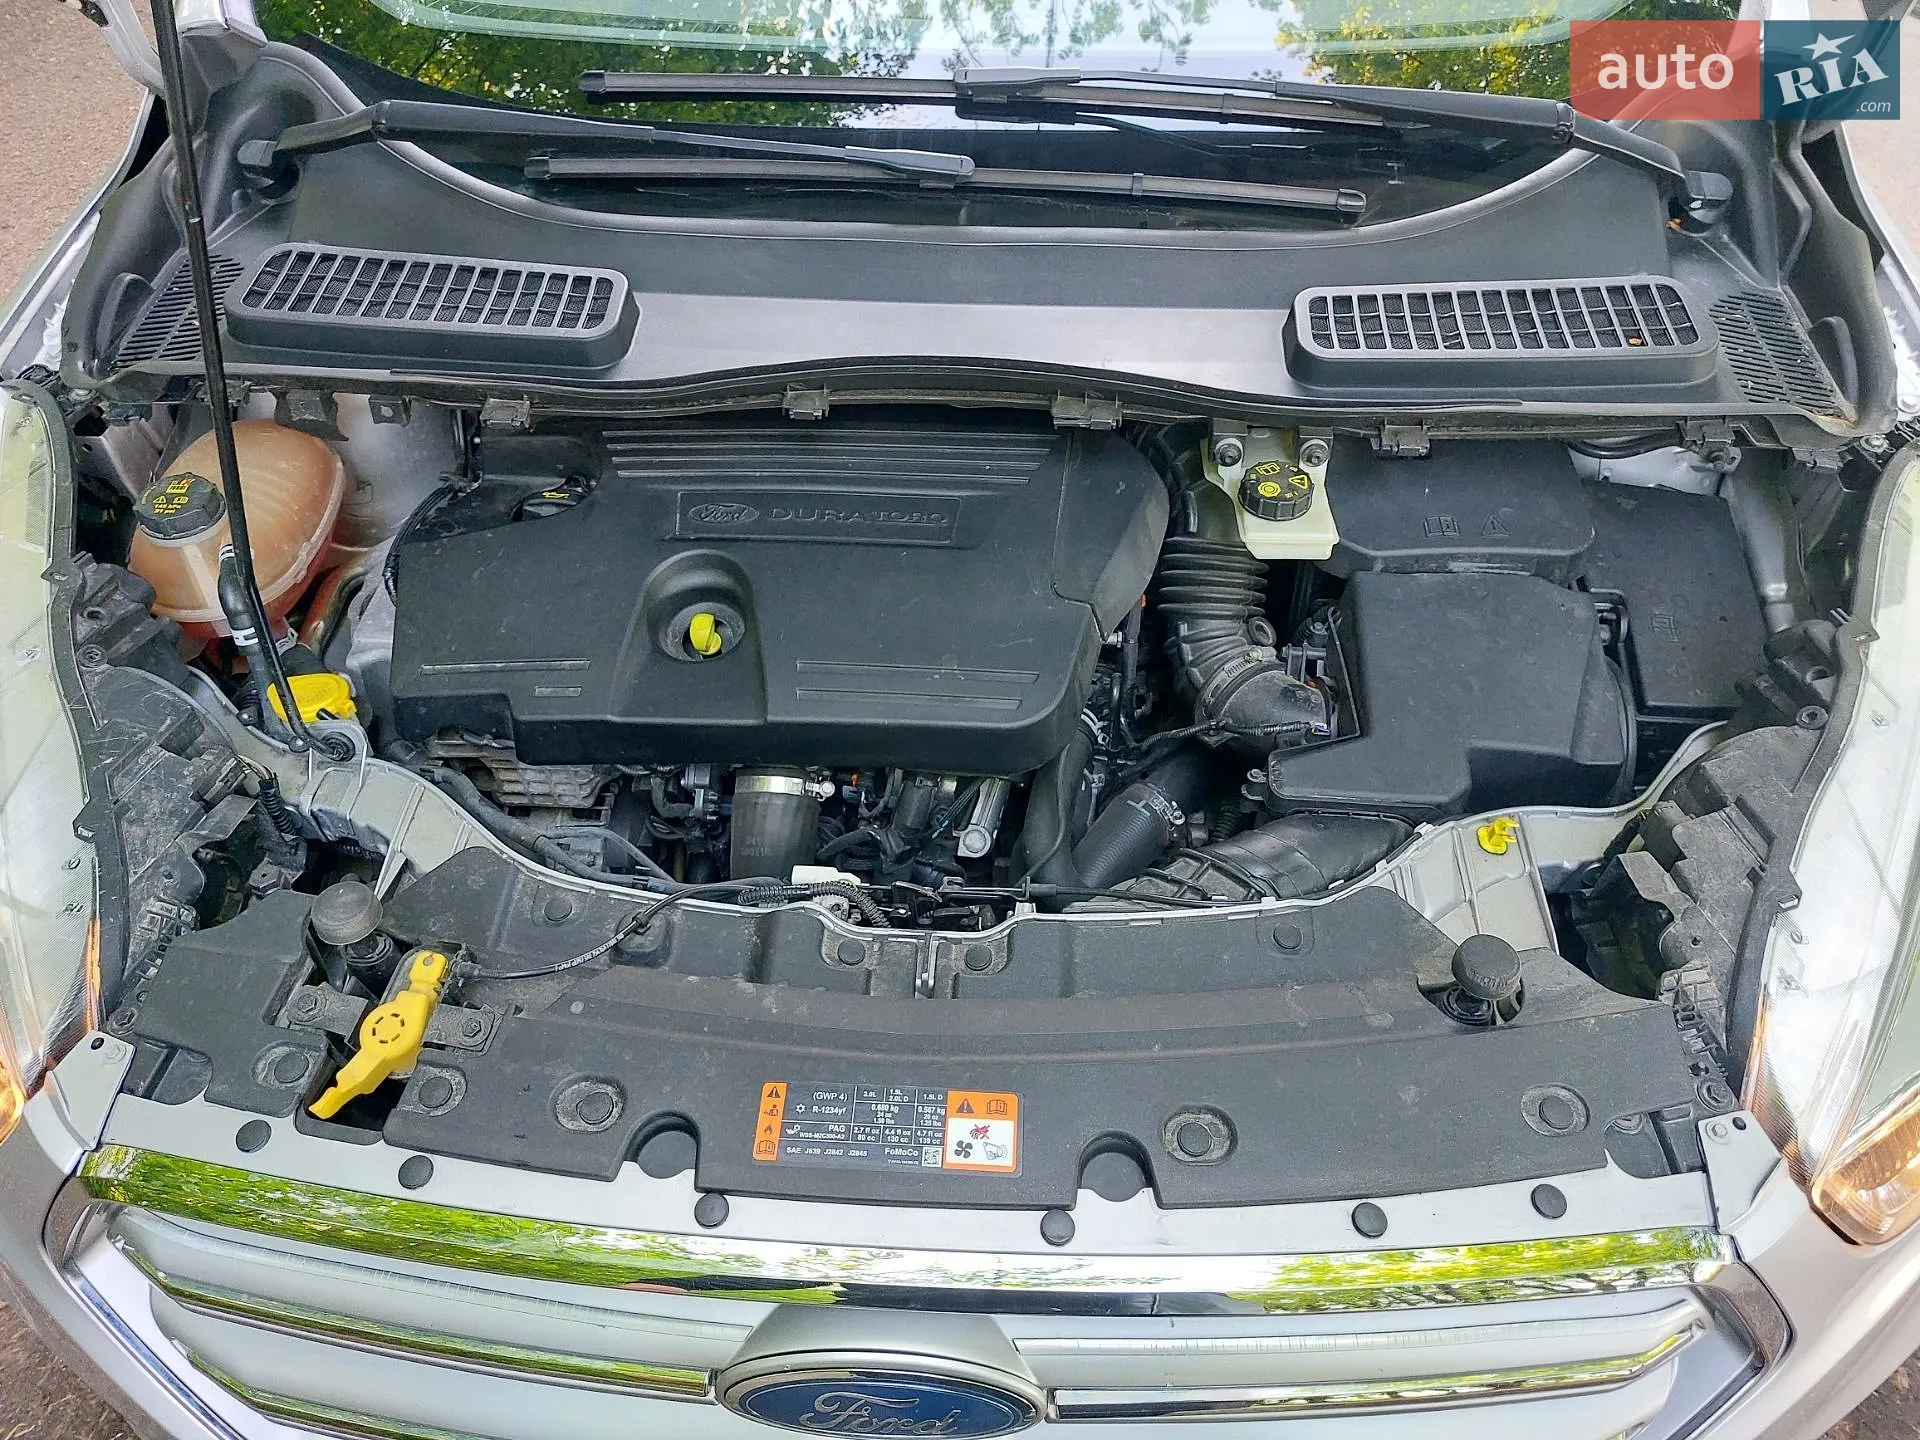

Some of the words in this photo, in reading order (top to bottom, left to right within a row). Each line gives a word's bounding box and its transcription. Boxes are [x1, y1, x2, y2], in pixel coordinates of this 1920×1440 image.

[699, 503, 748, 523] Ford
[812, 1091, 838, 1101] (GWP
[839, 1092, 848, 1102] 4)
[812, 1105, 847, 1116] R-1234yf
[890, 1104, 899, 1113] kg
[936, 1107, 946, 1115] kg
[828, 1124, 846, 1132] PAG
[786, 1146, 801, 1154] SAE
[884, 1147, 919, 1157] FoMoCo
[800, 1391, 961, 1434] Ford
